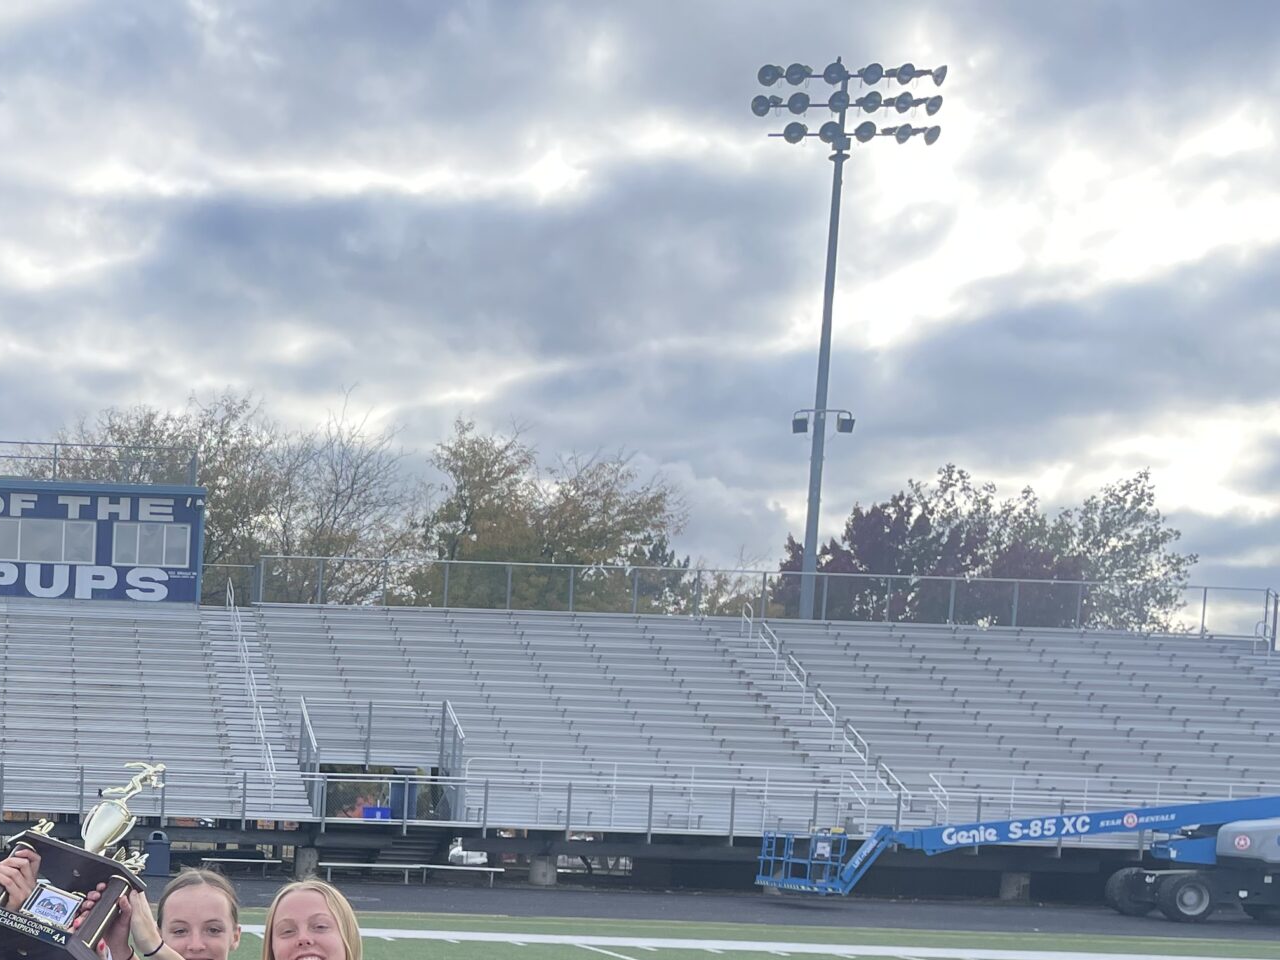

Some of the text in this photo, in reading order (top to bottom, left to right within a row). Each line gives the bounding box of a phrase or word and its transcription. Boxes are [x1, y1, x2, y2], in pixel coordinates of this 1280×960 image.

[58, 495, 175, 522] THE
[31, 818, 55, 836] 20
[1138, 813, 1176, 823] RENTALS
[942, 815, 1090, 845] Genie S-85 XC
[8, 913, 28, 925] CROSS
[26, 920, 55, 935] COUNTRY
[52, 933, 67, 945] 4A
